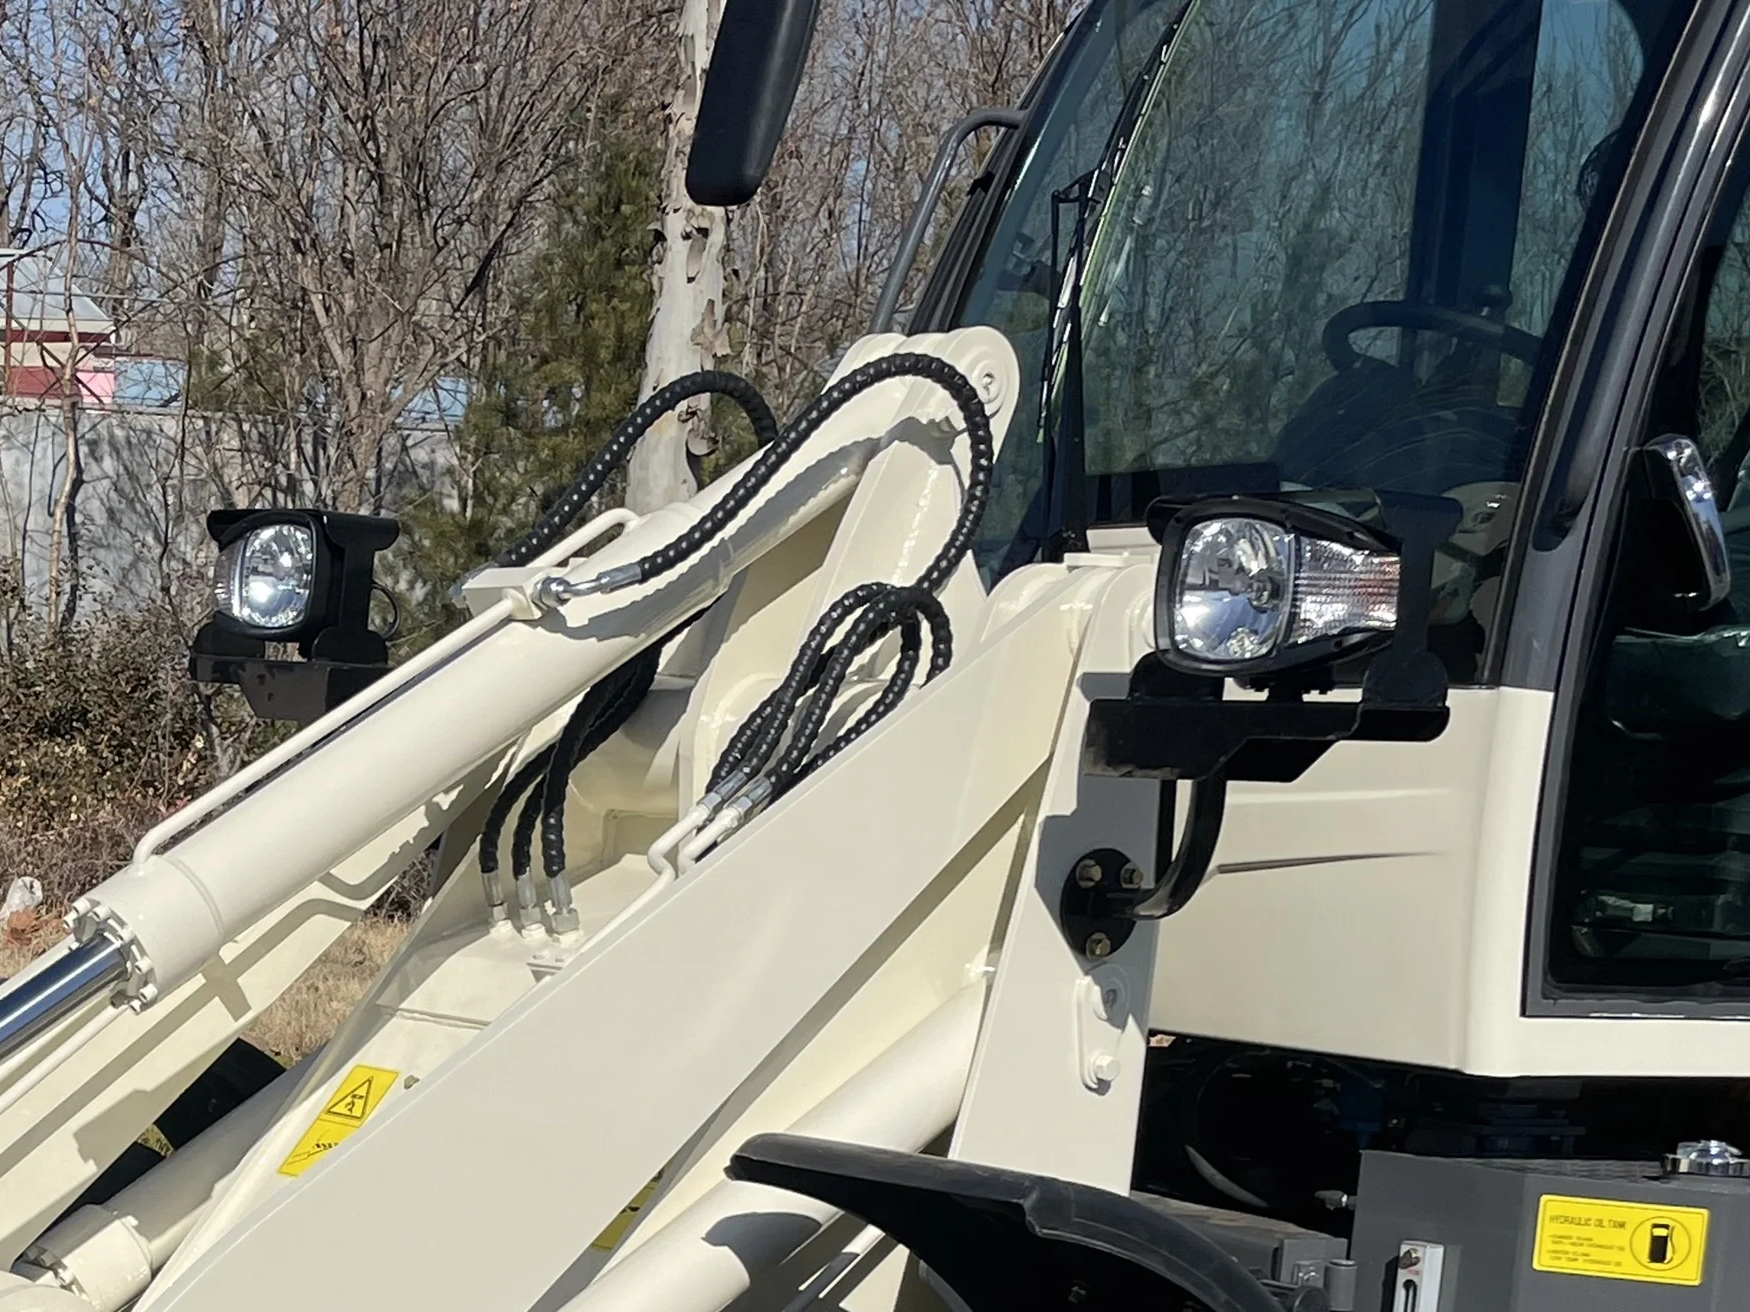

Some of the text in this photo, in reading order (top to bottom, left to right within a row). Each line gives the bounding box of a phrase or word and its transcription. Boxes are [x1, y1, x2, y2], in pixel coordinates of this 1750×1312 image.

[1549, 1214, 1626, 1229] HYDRAULIC OIL TANK
